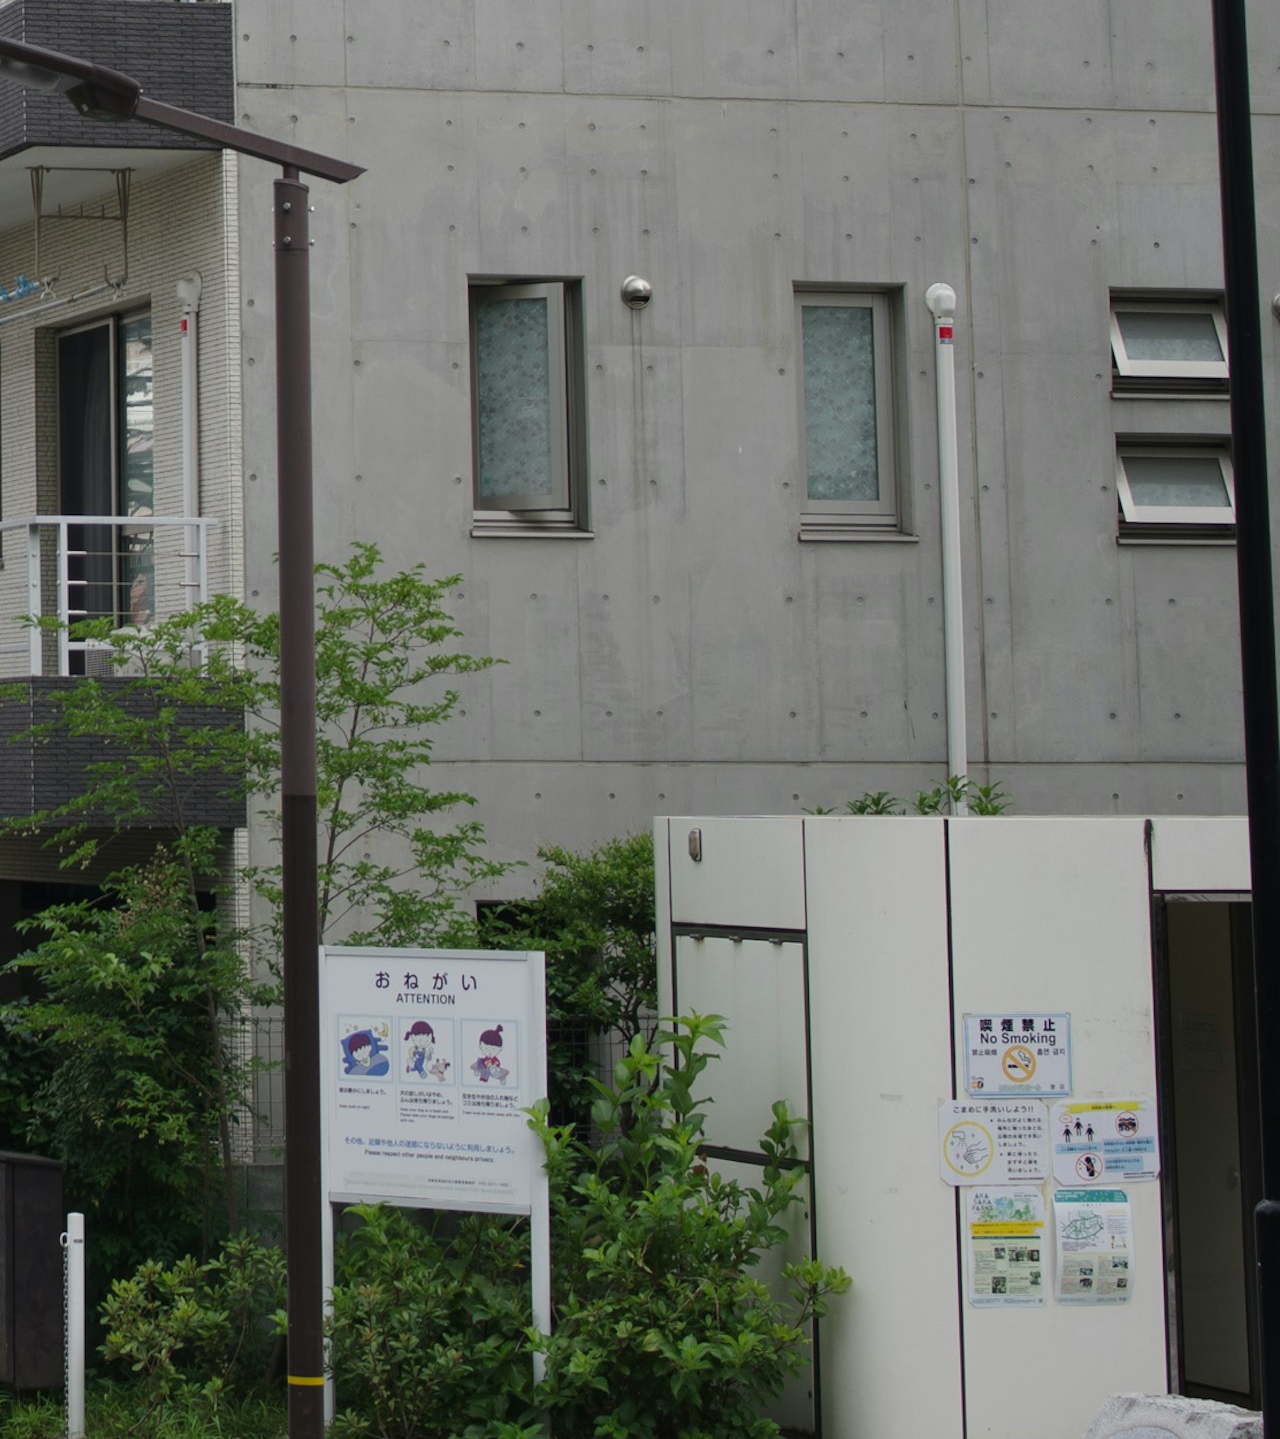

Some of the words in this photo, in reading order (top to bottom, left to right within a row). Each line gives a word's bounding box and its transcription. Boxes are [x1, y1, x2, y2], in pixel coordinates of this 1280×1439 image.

[375, 971, 477, 991] おねがい
[396, 993, 456, 1005] ATTENTION
[979, 1018, 1056, 1032] 喫煙禁止
[980, 1032, 998, 1044] No
[1001, 1032, 1056, 1046] Smoking
